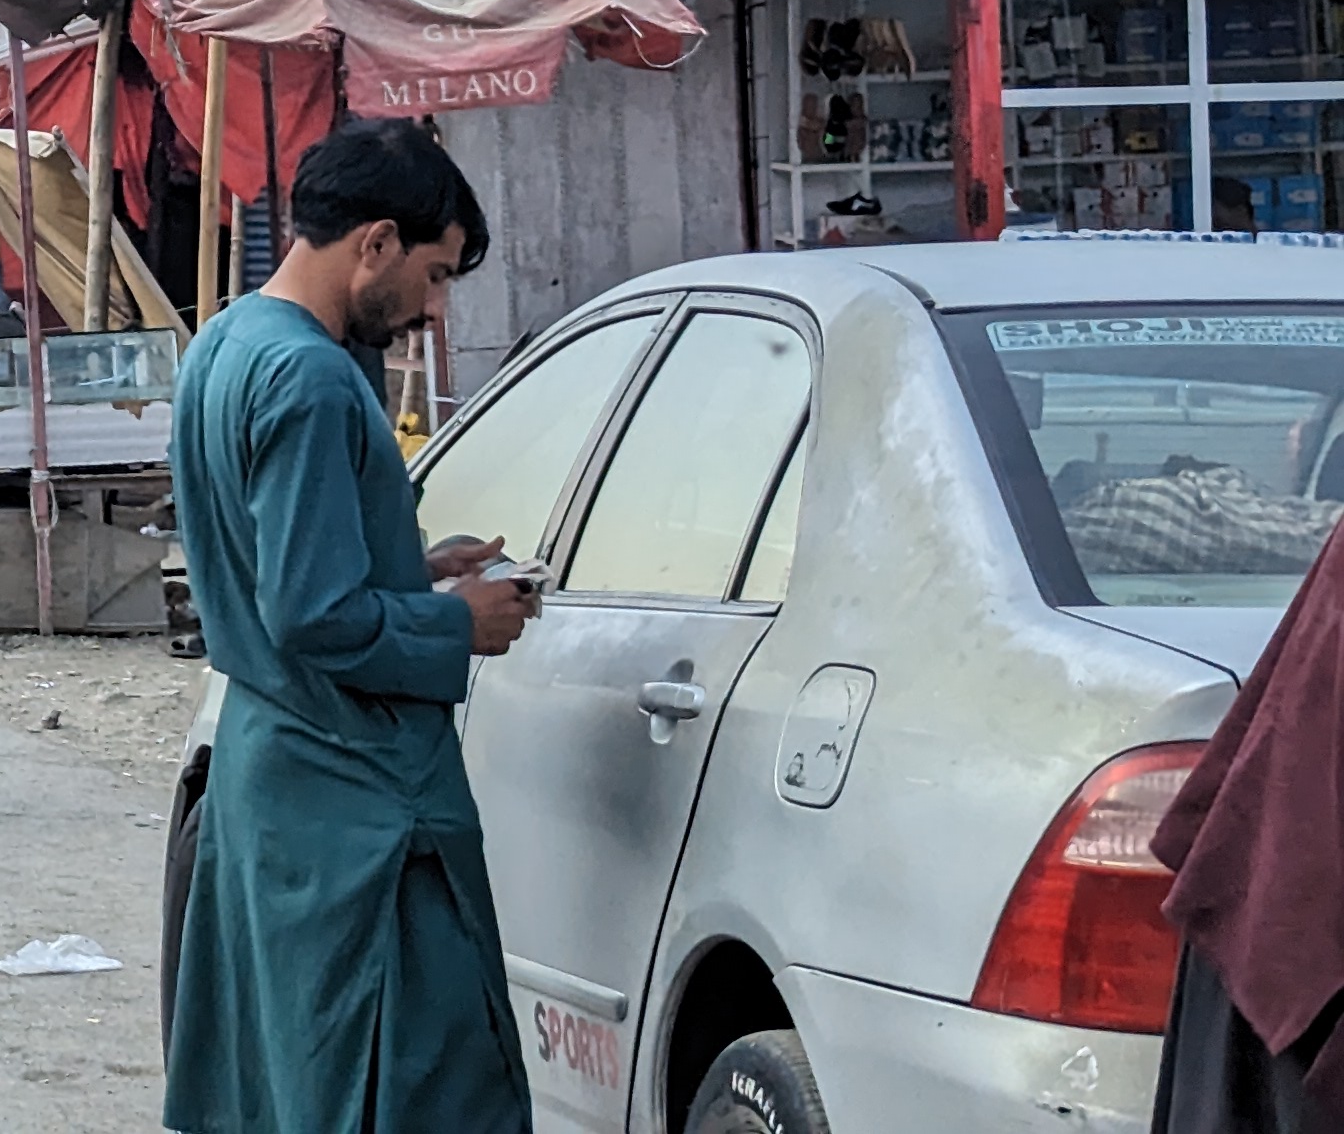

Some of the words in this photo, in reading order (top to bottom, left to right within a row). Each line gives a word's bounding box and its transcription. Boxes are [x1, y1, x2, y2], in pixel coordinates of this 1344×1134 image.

[381, 69, 538, 107] MILANO
[1002, 319, 1206, 337] SHOJI
[533, 1000, 621, 1090] SPORTS
